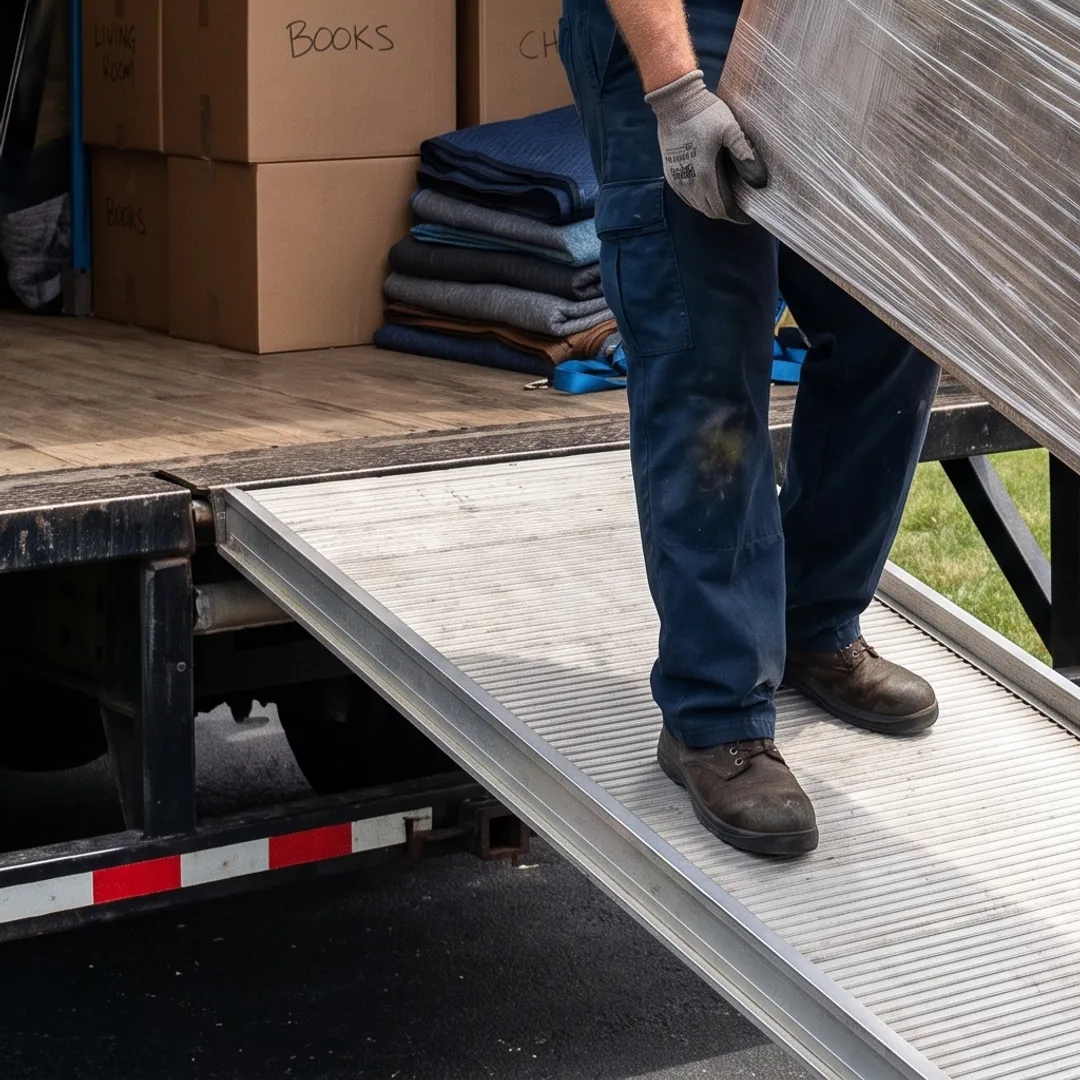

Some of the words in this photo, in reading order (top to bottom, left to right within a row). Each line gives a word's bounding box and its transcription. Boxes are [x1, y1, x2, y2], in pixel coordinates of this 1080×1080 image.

[94, 20, 136, 56] LIVING
[285, 19, 395, 59] BOOKS
[519, 29, 559, 60] CH
[102, 54, 136, 87] ROOM
